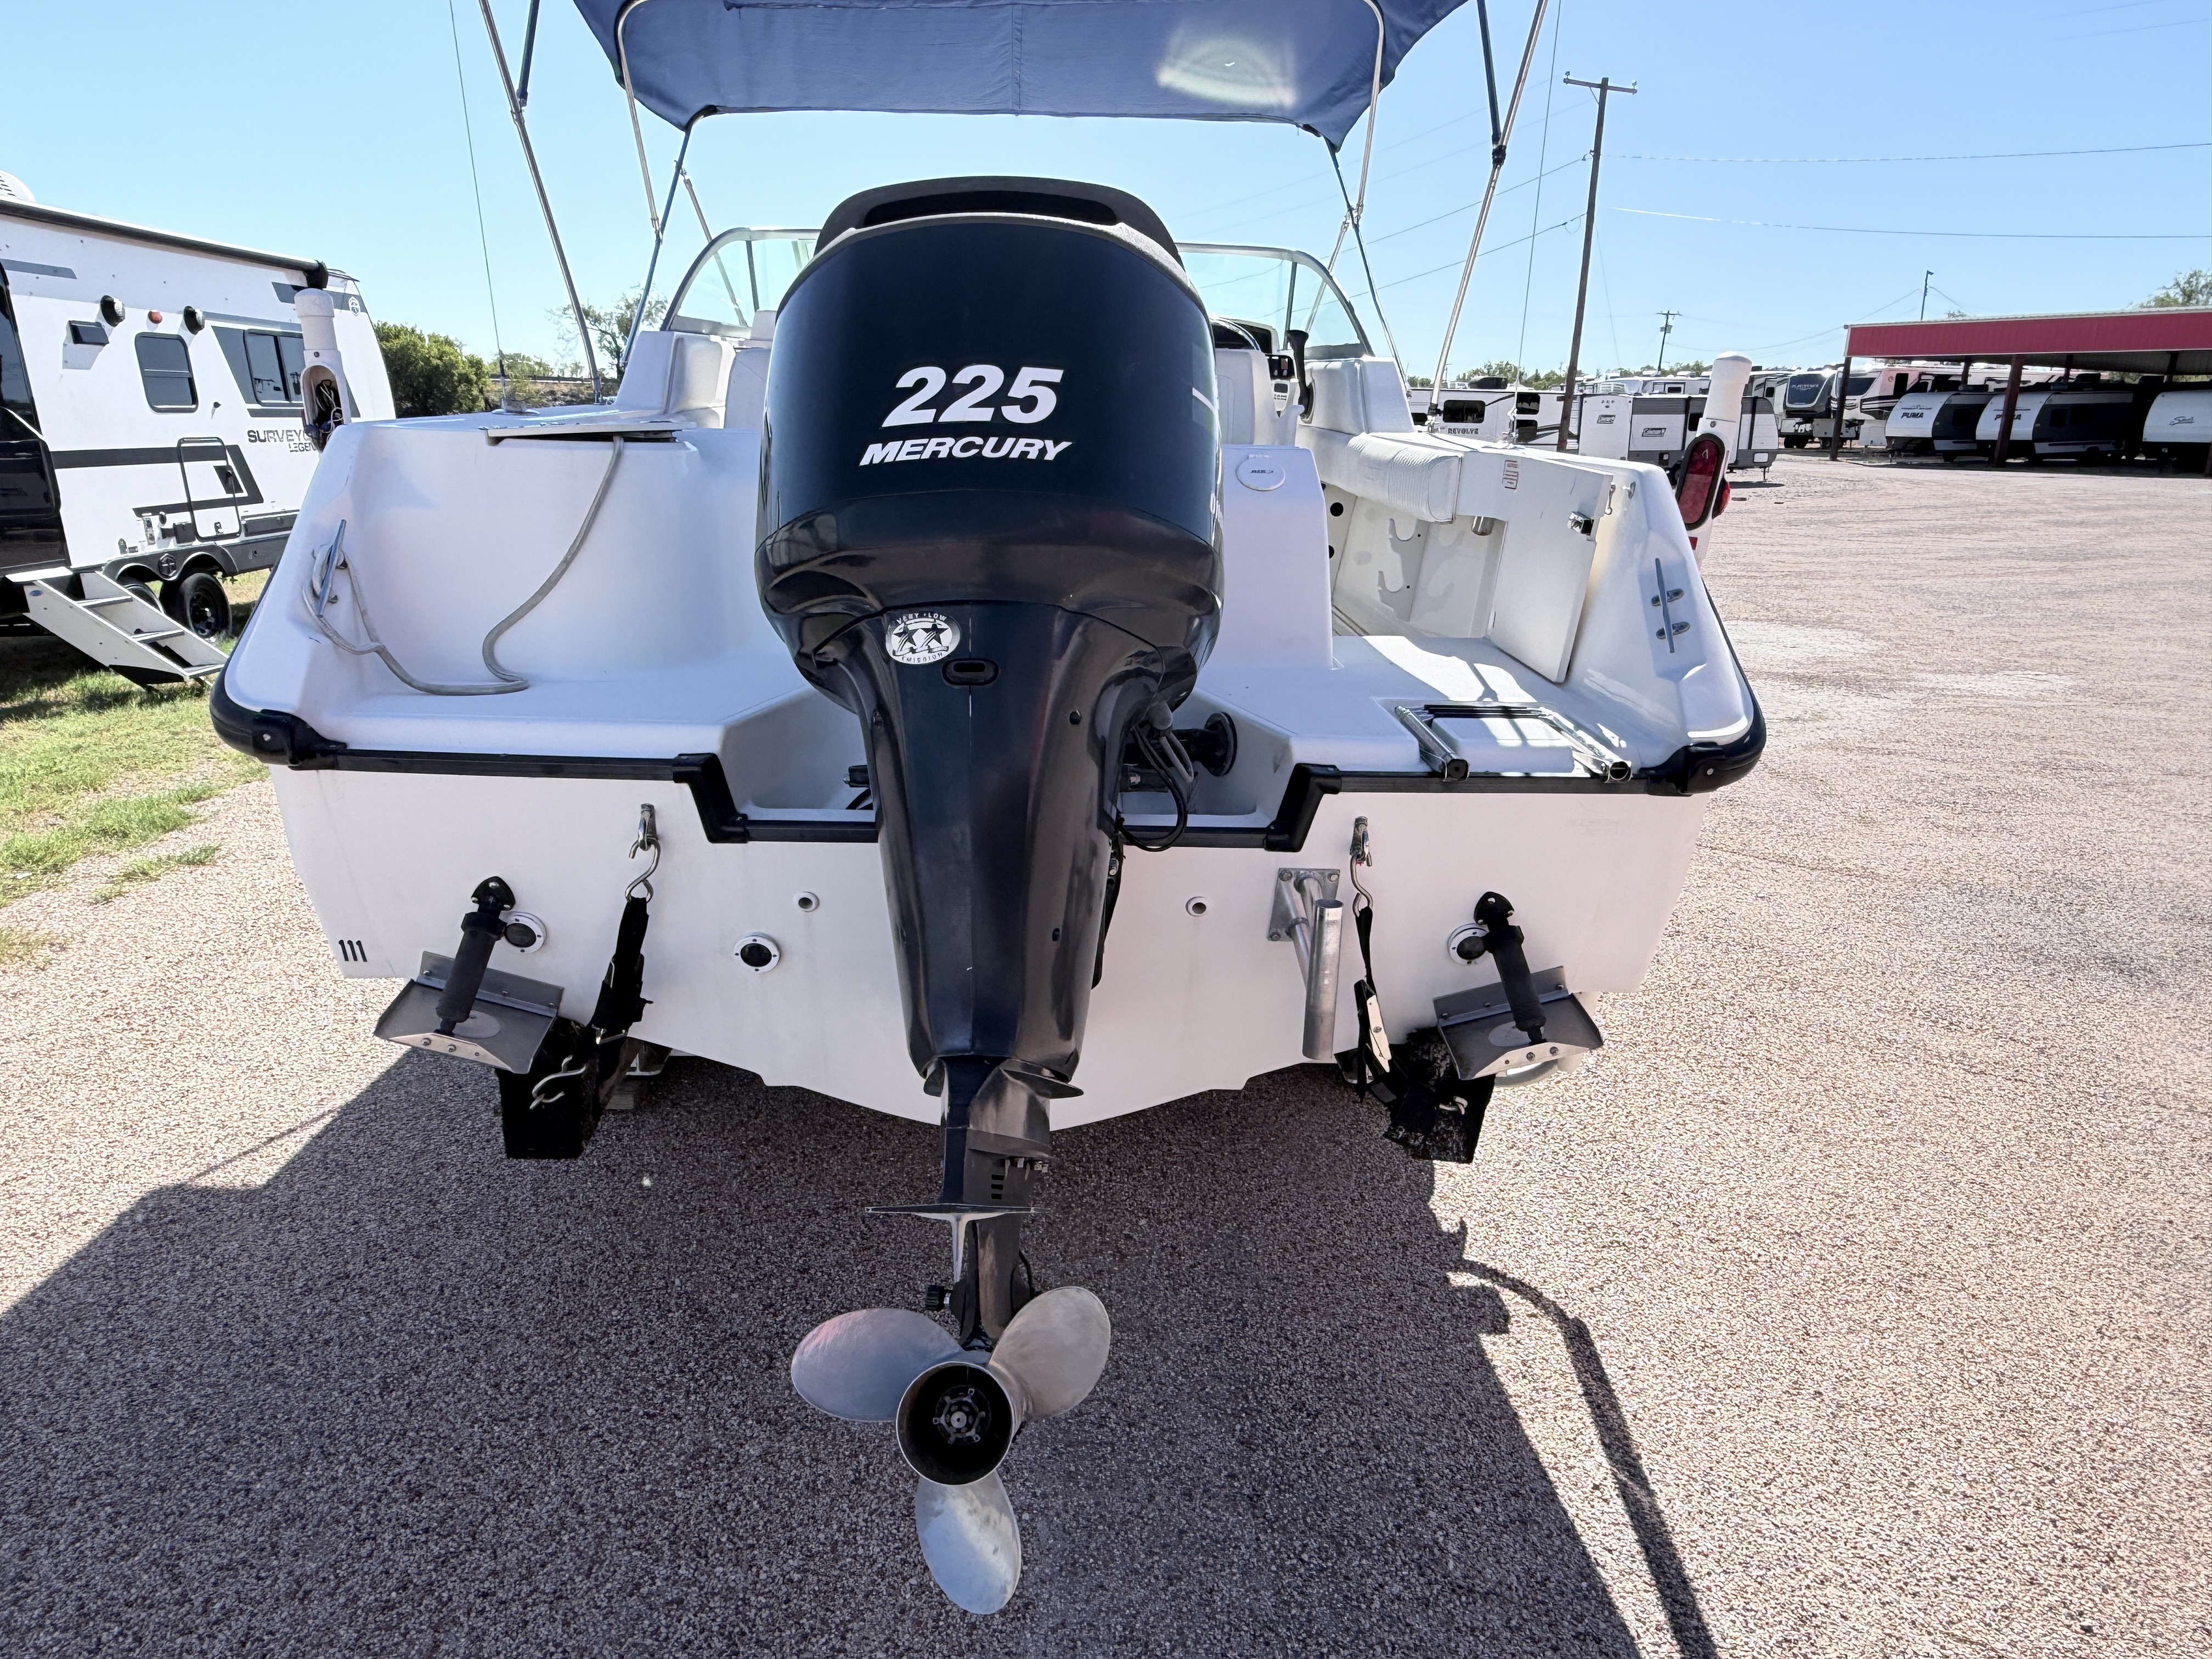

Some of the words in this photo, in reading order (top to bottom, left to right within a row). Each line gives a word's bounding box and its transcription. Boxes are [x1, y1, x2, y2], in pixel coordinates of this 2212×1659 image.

[881, 364, 1064, 428] 225
[247, 430, 312, 443] SURVEY
[289, 442, 317, 453] LEGEN
[859, 436, 1073, 467] MERCURY
[928, 612, 947, 621] LOW
